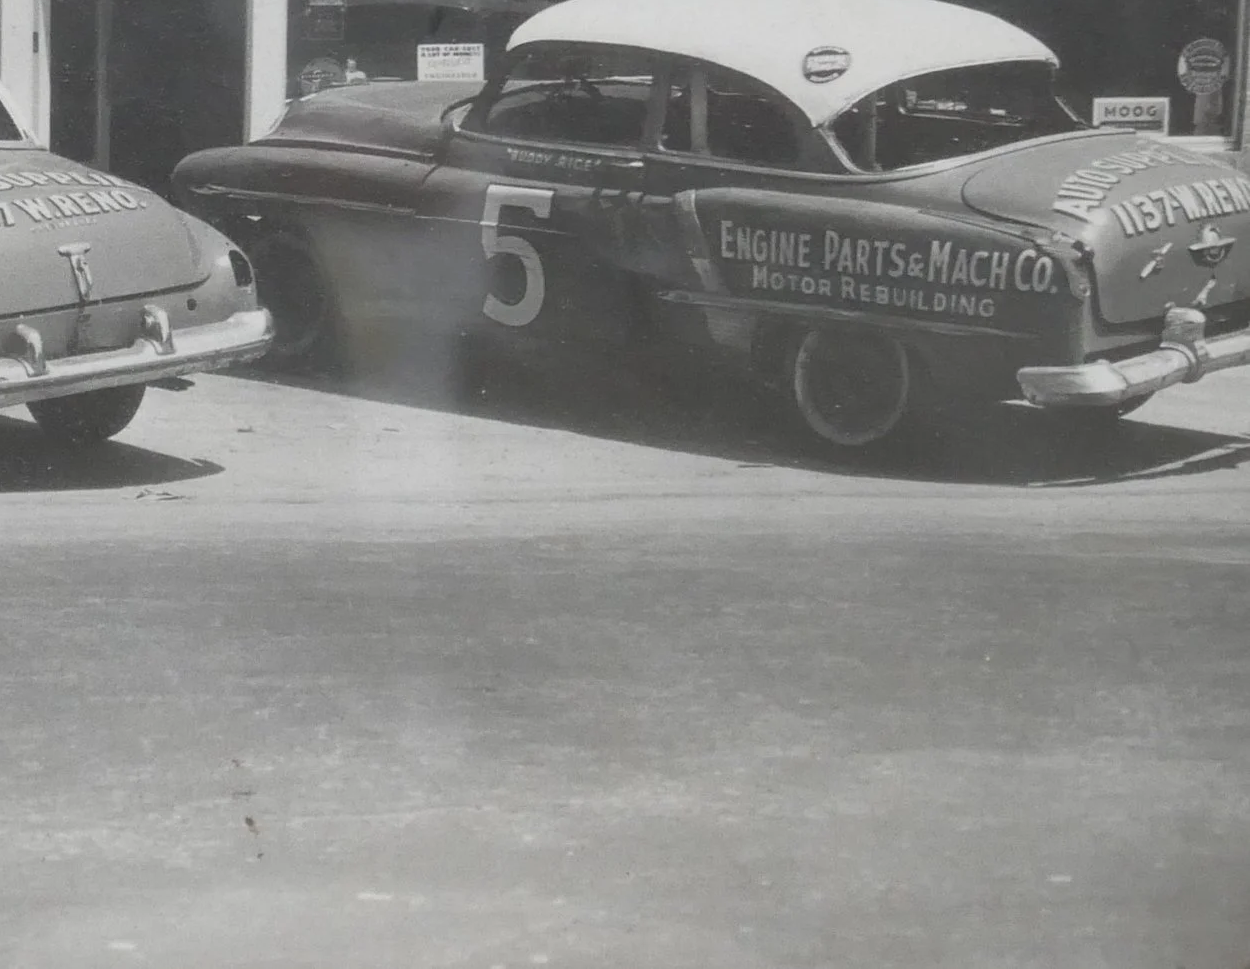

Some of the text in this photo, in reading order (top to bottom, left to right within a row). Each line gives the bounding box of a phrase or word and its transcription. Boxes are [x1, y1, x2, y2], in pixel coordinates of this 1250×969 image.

[1103, 104, 1158, 118] MOOG
[1052, 169, 1120, 224] AUTO
[481, 184, 555, 327] 5
[720, 220, 812, 269] ENGINE
[823, 230, 907, 279] PARTS
[927, 240, 1012, 292] MACH
[752, 265, 997, 319] MOTOR REBUILDING
